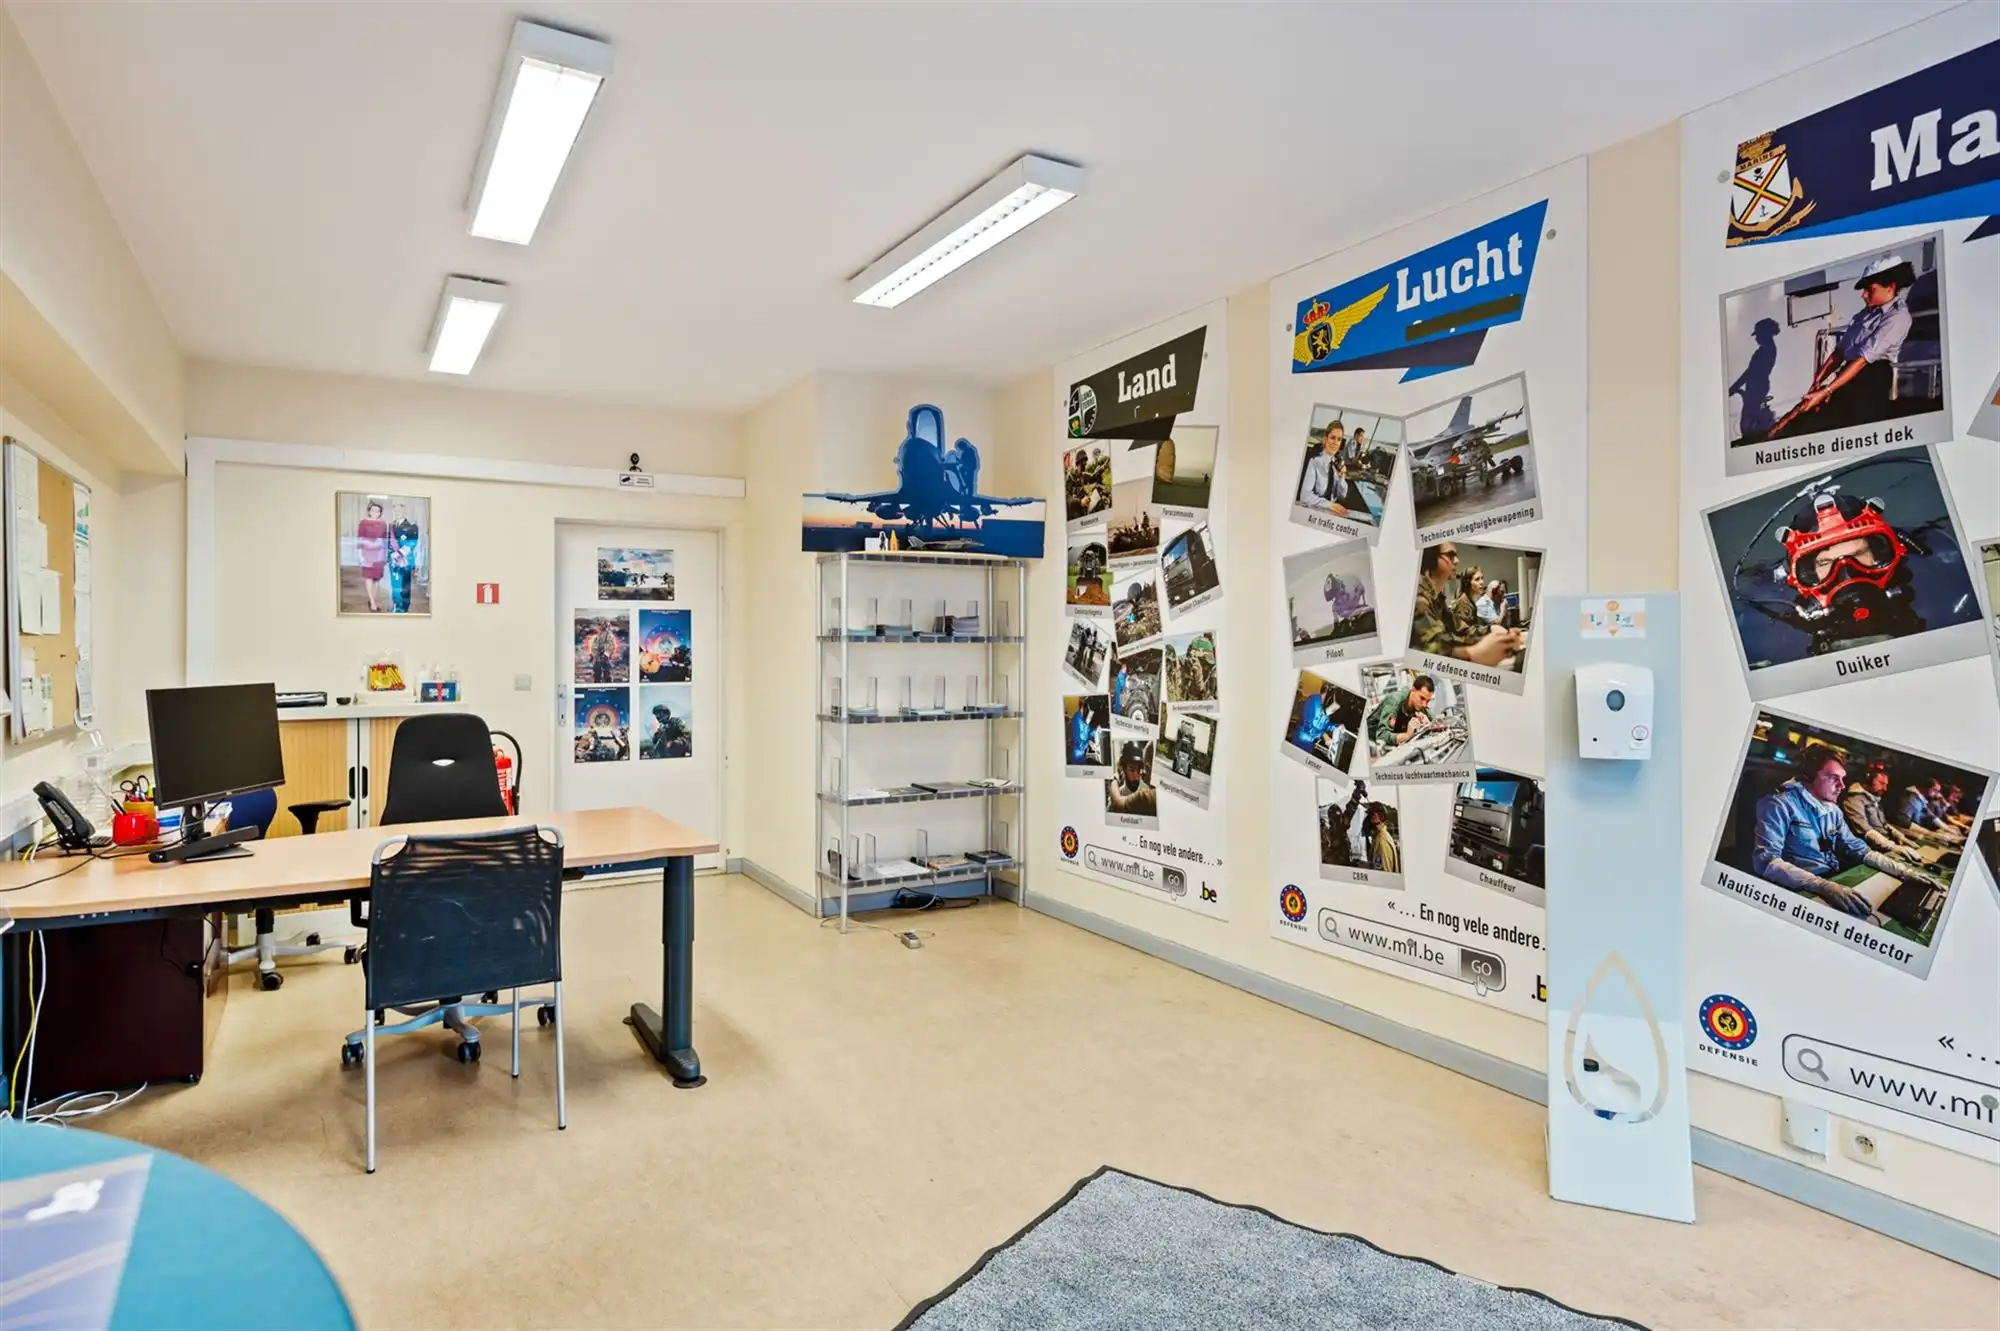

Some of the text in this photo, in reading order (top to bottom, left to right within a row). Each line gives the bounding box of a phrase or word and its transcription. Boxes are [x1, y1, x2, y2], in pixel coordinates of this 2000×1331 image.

[1740, 151, 1774, 170] MARINE
[1396, 232, 1522, 312] Lucht
[1118, 353, 1176, 403] Land
[1756, 426, 1914, 465] Nautische dienst dek
[1308, 514, 1359, 537] Air trafic control
[1420, 508, 1535, 543] Technicus vliegtuigbewapening
[1423, 658, 1501, 686] Air defence control
[1836, 654, 1890, 676] Duiker
[1375, 769, 1470, 780] Technicus luchtvaartmechanica
[1139, 835, 1147, 849] En
[1149, 841, 1161, 856] nog
[1162, 843, 1177, 857] vele
[1168, 874, 1180, 886] GO
[1352, 872, 1369, 882] CBRN
[1479, 872, 1516, 893] Chauffeur
[1280, 919, 1308, 932] DEFENSIE
[1420, 903, 1434, 921] En
[1437, 912, 1460, 933] nog
[1463, 916, 1489, 936] vele
[1718, 872, 1914, 965] Nautische dienst detector
[1349, 927, 1445, 965] www.mil.be
[1471, 959, 1493, 977] GO
[1699, 1043, 1758, 1067] DEFENSIE
